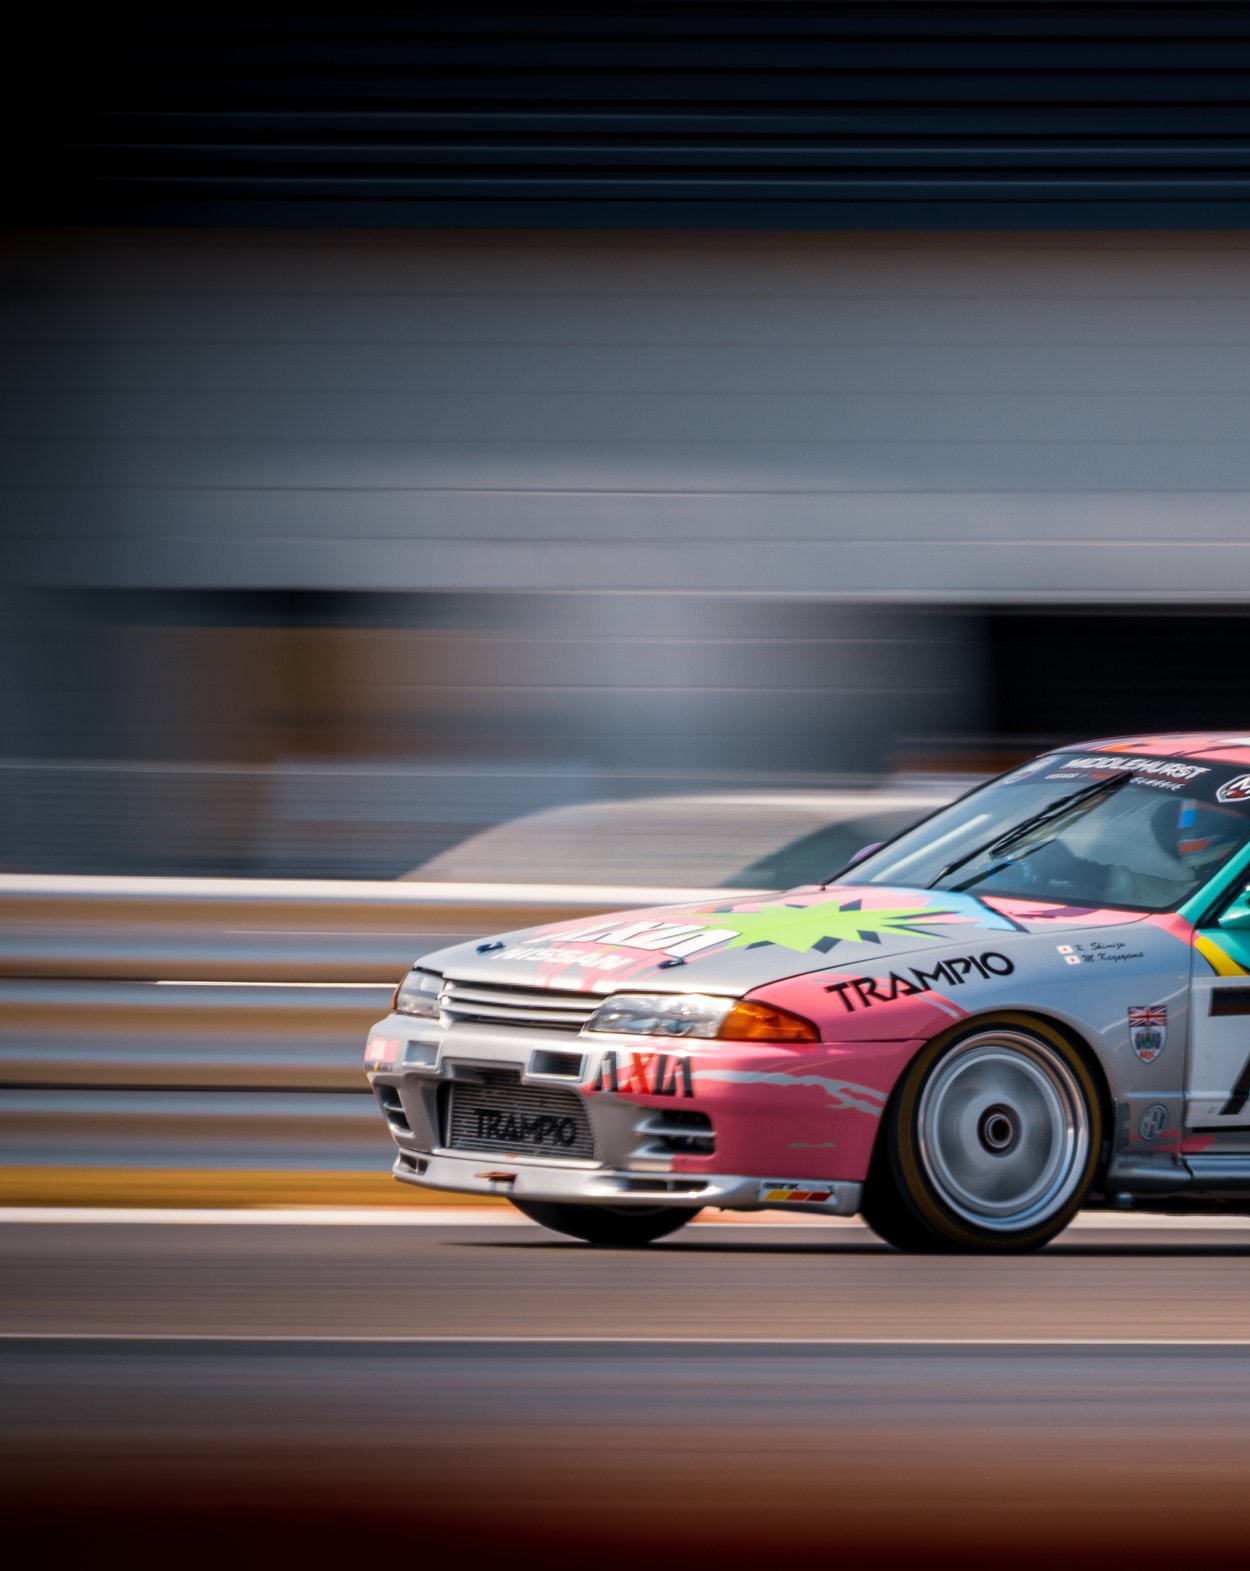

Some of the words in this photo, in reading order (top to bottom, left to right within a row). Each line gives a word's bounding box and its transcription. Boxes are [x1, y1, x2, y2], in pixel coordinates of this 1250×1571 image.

[1060, 757, 1212, 780] MIDDLEHURST
[491, 948, 636, 971] NISSAN
[826, 951, 1015, 1013] TRAMPIO
[474, 1108, 577, 1148] TRAMPIO
